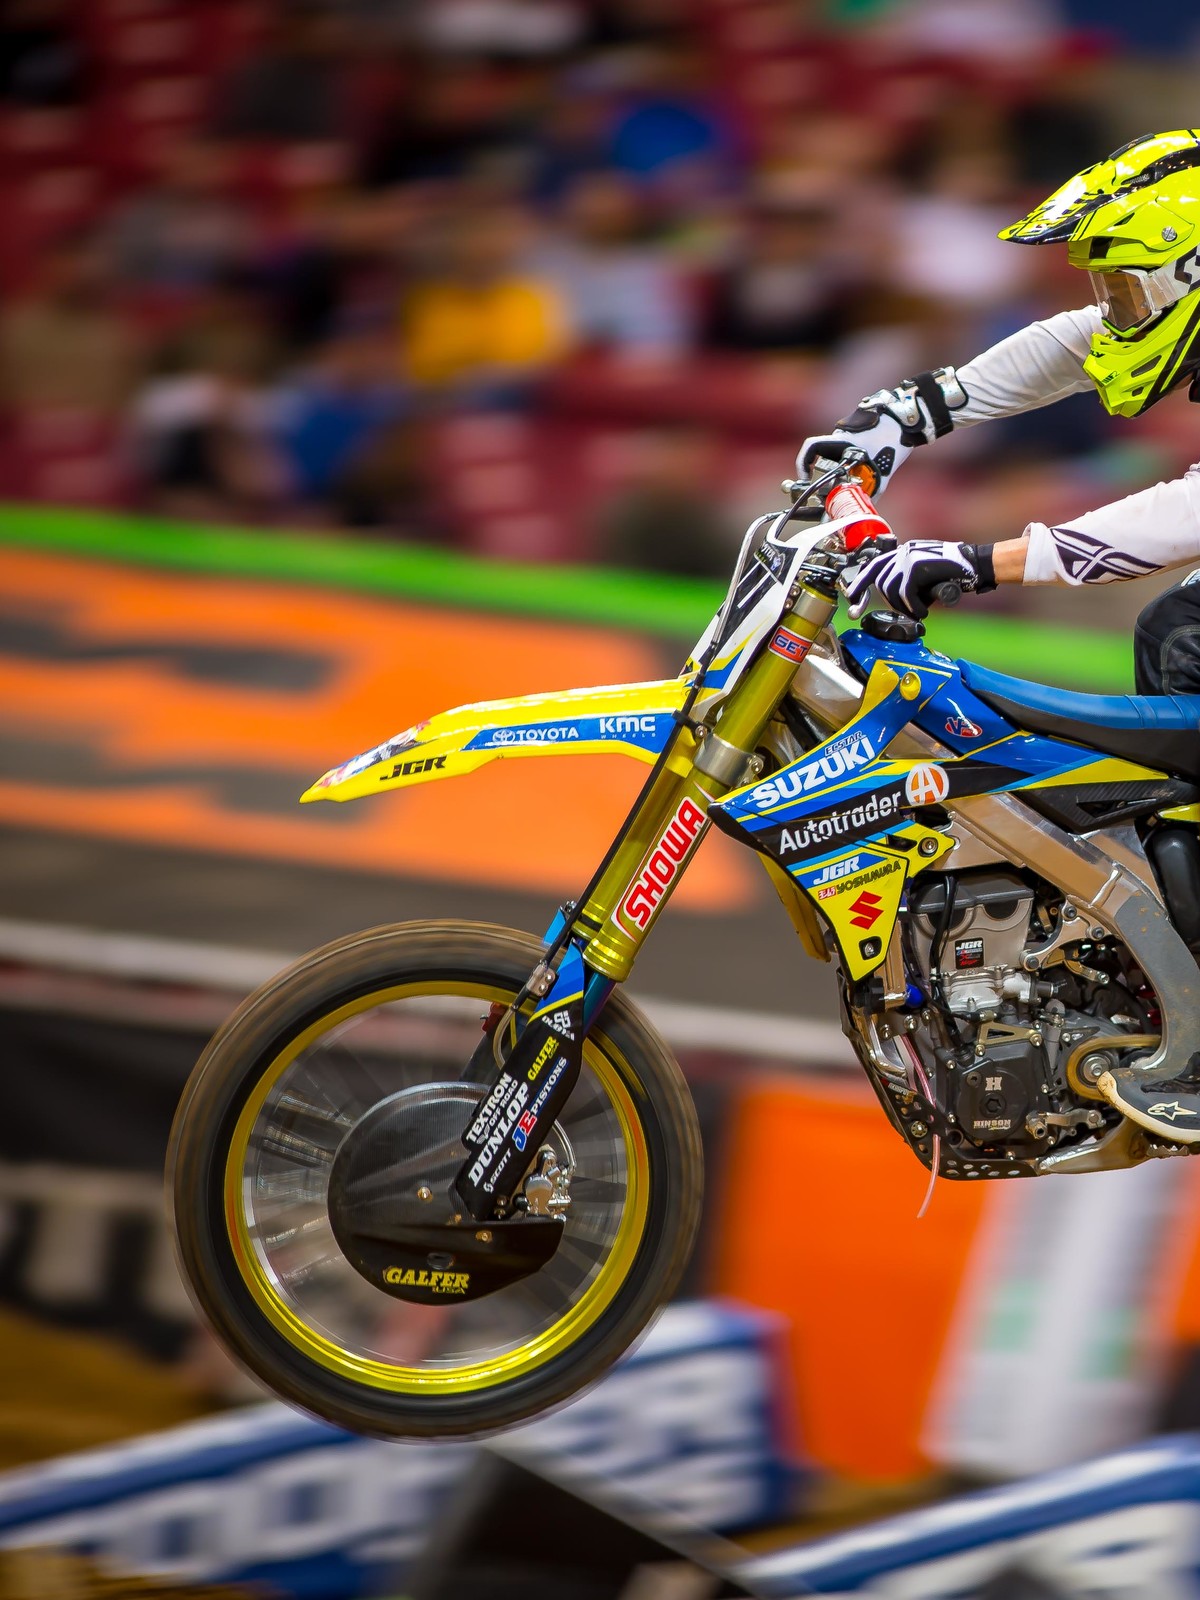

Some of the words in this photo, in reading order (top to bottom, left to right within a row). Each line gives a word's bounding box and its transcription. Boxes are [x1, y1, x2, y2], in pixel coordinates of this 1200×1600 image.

[774, 634, 807, 657] GET
[516, 726, 579, 741] TOYOTA
[825, 731, 863, 756] ECSTAR
[379, 755, 447, 781] JGR
[748, 737, 875, 808] SUZUKI
[780, 793, 901, 855] Autotrader
[625, 799, 705, 928] SHOWA
[813, 856, 860, 886] JGR
[837, 861, 901, 894] YOSHIMURA
[956, 940, 983, 950] JGR
[527, 1036, 557, 1081] GALFER
[466, 1072, 513, 1143] TEXTRON
[489, 1108, 501, 1127] OFF
[500, 1080, 518, 1108] ROAD
[512, 1110, 538, 1152] JE
[531, 1057, 567, 1115] PISTONS
[468, 1082, 529, 1188] DUNLOP
[973, 1119, 1011, 1128] HINSON
[490, 1148, 512, 1186] SCOTT
[386, 1268, 469, 1289] GALFER
